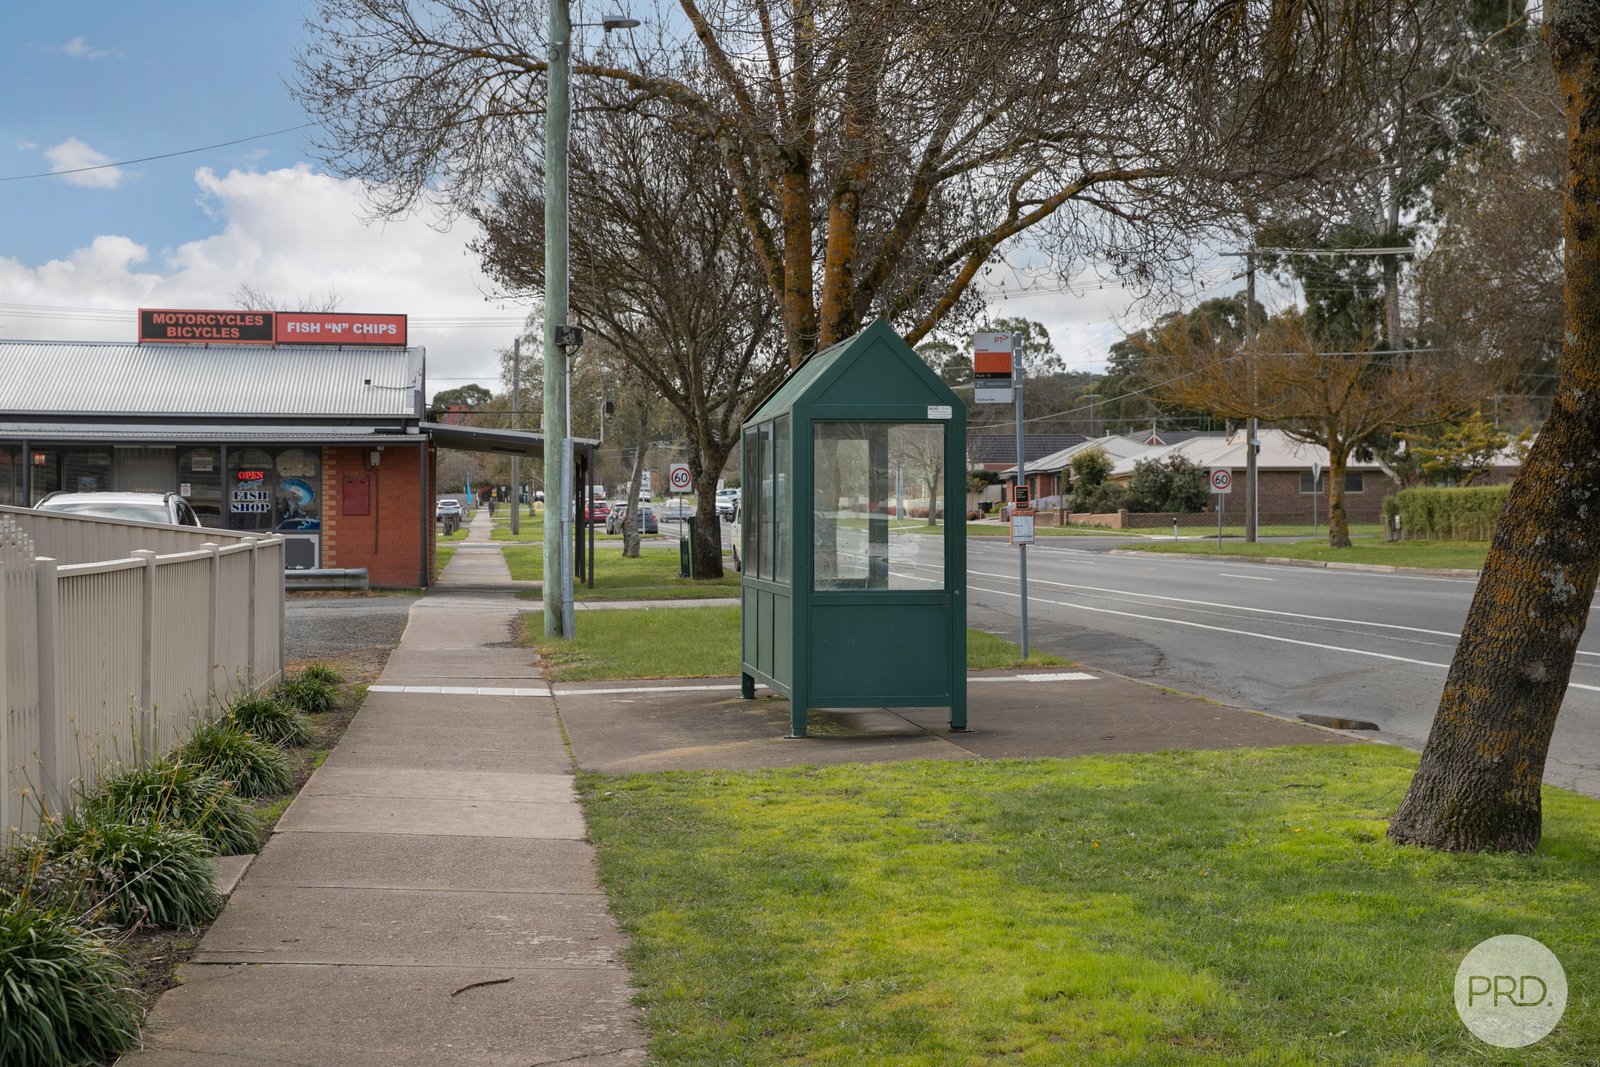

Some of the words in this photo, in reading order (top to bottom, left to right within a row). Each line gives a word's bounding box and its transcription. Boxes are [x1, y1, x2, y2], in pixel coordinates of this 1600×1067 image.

[152, 313, 264, 326] MOTORCYCLES
[166, 326, 240, 338] BICYCLES
[287, 322, 320, 333] FISH
[324, 322, 349, 334] “N”
[353, 323, 397, 335] CHIPS
[976, 380, 984, 388] 21
[237, 471, 264, 480] OPEN
[674, 472, 688, 483] 60
[1214, 474, 1228, 485] 60
[232, 490, 269, 501] FISH
[231, 502, 271, 513] SHOP
